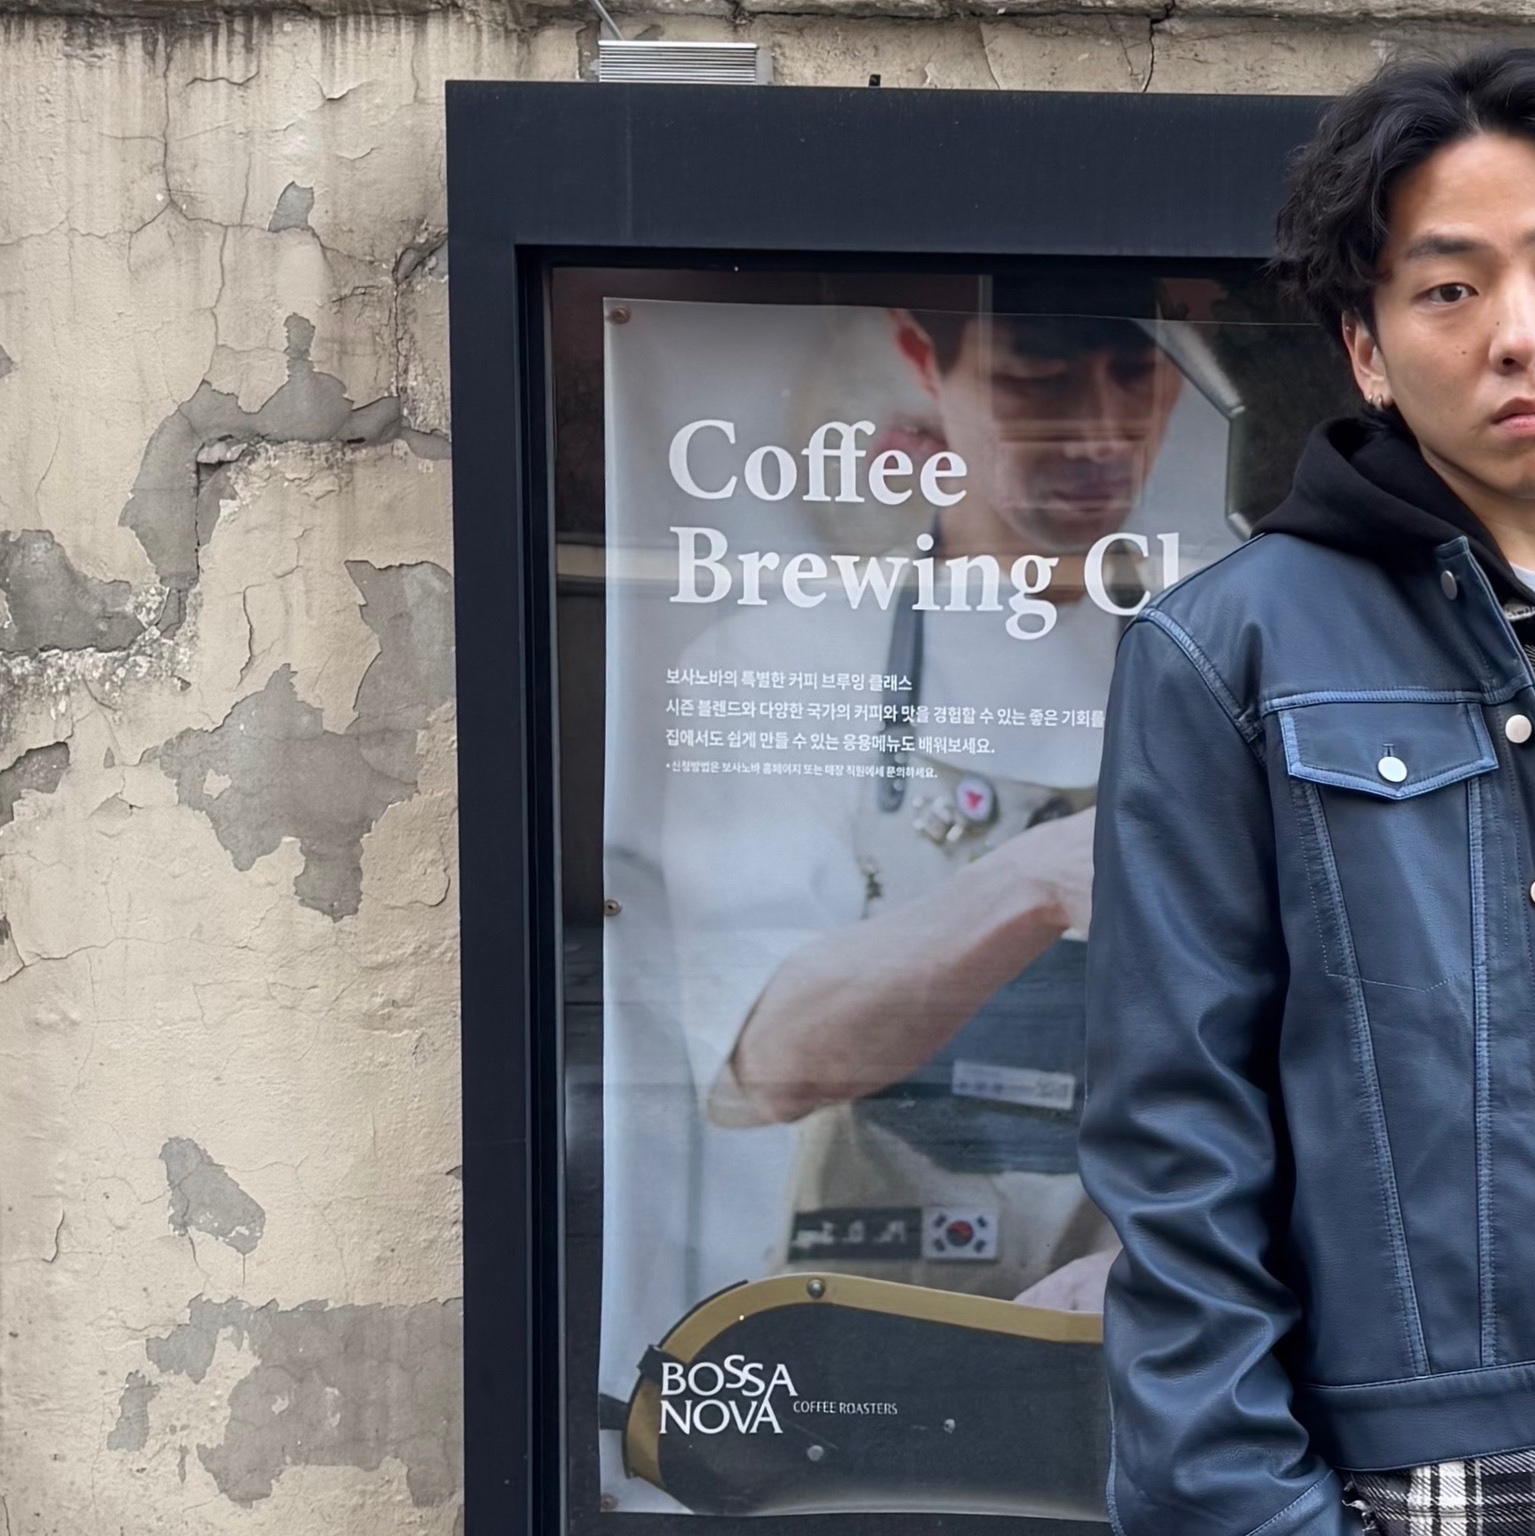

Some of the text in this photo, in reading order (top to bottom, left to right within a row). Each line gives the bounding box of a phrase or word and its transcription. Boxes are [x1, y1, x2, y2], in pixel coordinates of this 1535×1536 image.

[668, 419, 968, 507] Coffee
[669, 527, 1059, 641] Brewing
[666, 668, 913, 692] 보사노바의 특별한 커피 브루잉 클래스
[666, 698, 1105, 728] 시즌 블렌드와 다양한 국가의 커피와 맛을 경험할 수 있는 좋은 기회를
[666, 729, 995, 754] 집에서도 쉽게 만들 수 있는 응용메뉴도 배워보세요.
[721, 761, 760, 774] 보사노바
[661, 1354, 798, 1398] BOSSA
[659, 1398, 898, 1435] NOVA COFFEE ROASTERS
